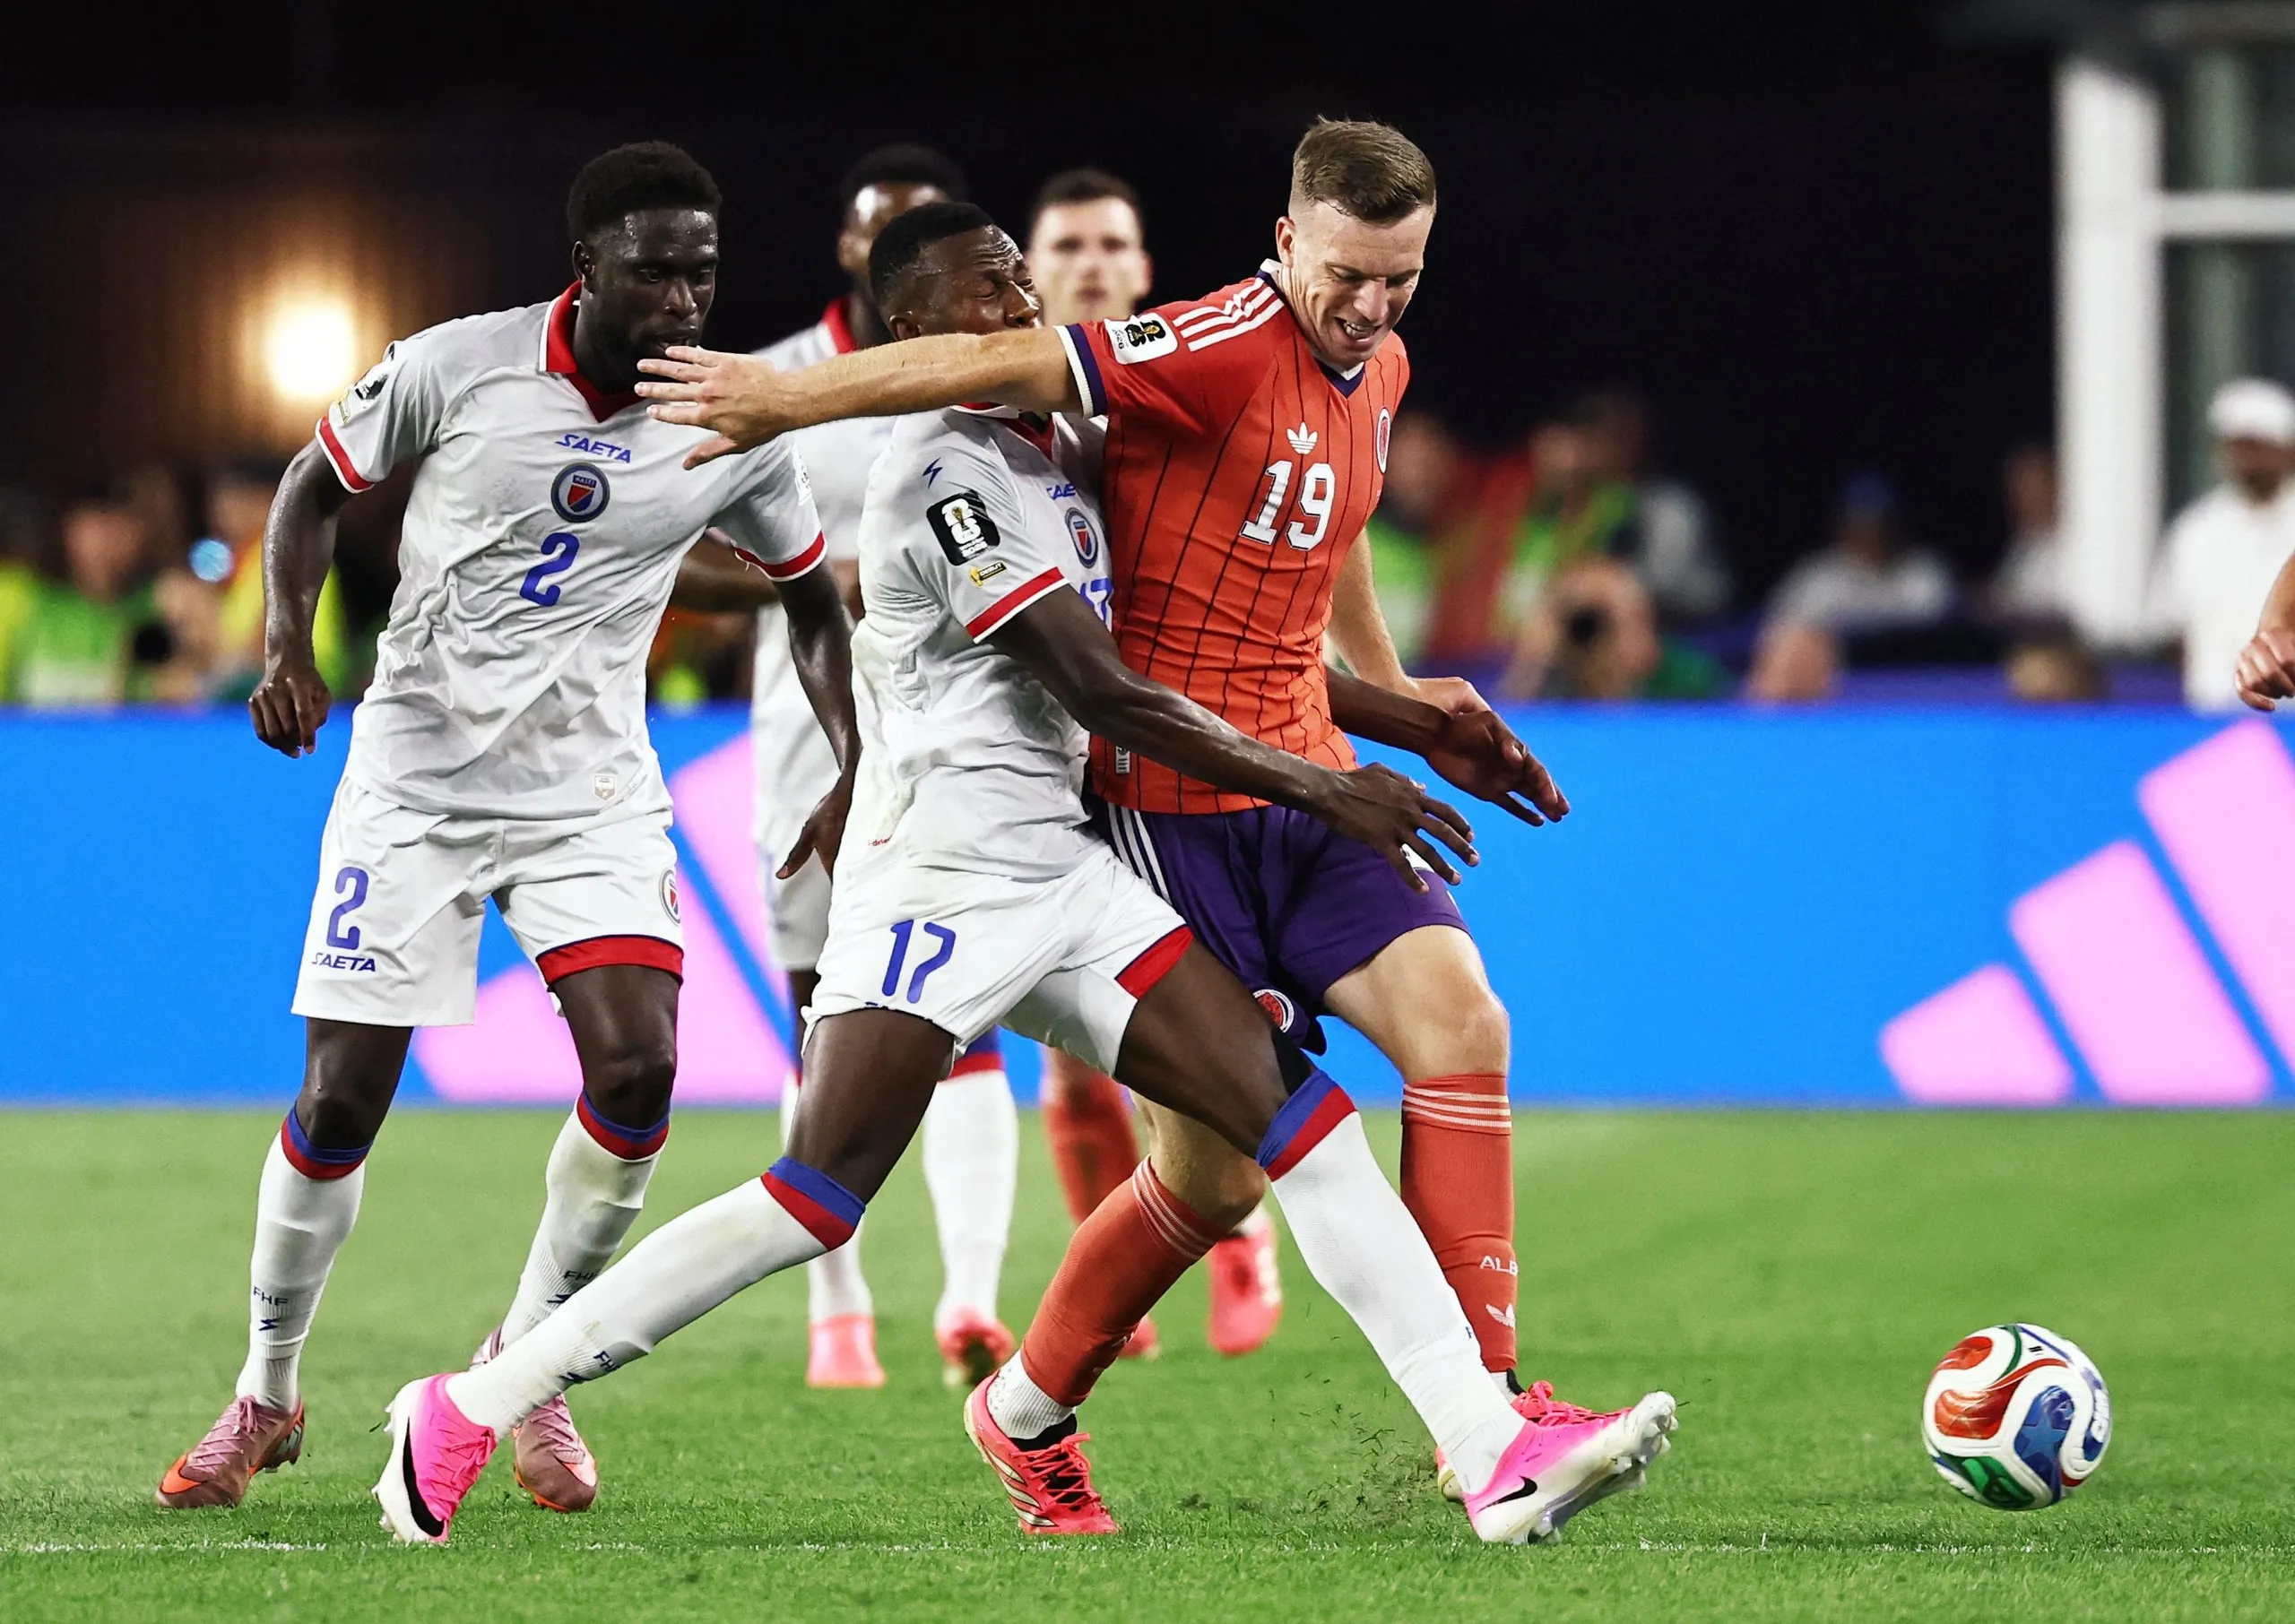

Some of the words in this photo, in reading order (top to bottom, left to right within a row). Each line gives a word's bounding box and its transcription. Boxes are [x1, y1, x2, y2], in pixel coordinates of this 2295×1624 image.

[554, 434, 631, 464] SAETA
[1239, 460, 1336, 552] 19
[519, 531, 580, 608] 2
[325, 866, 369, 951] 2
[311, 952, 377, 972] SAETA
[881, 918, 957, 1005] 17
[253, 1286, 289, 1307] FHF
